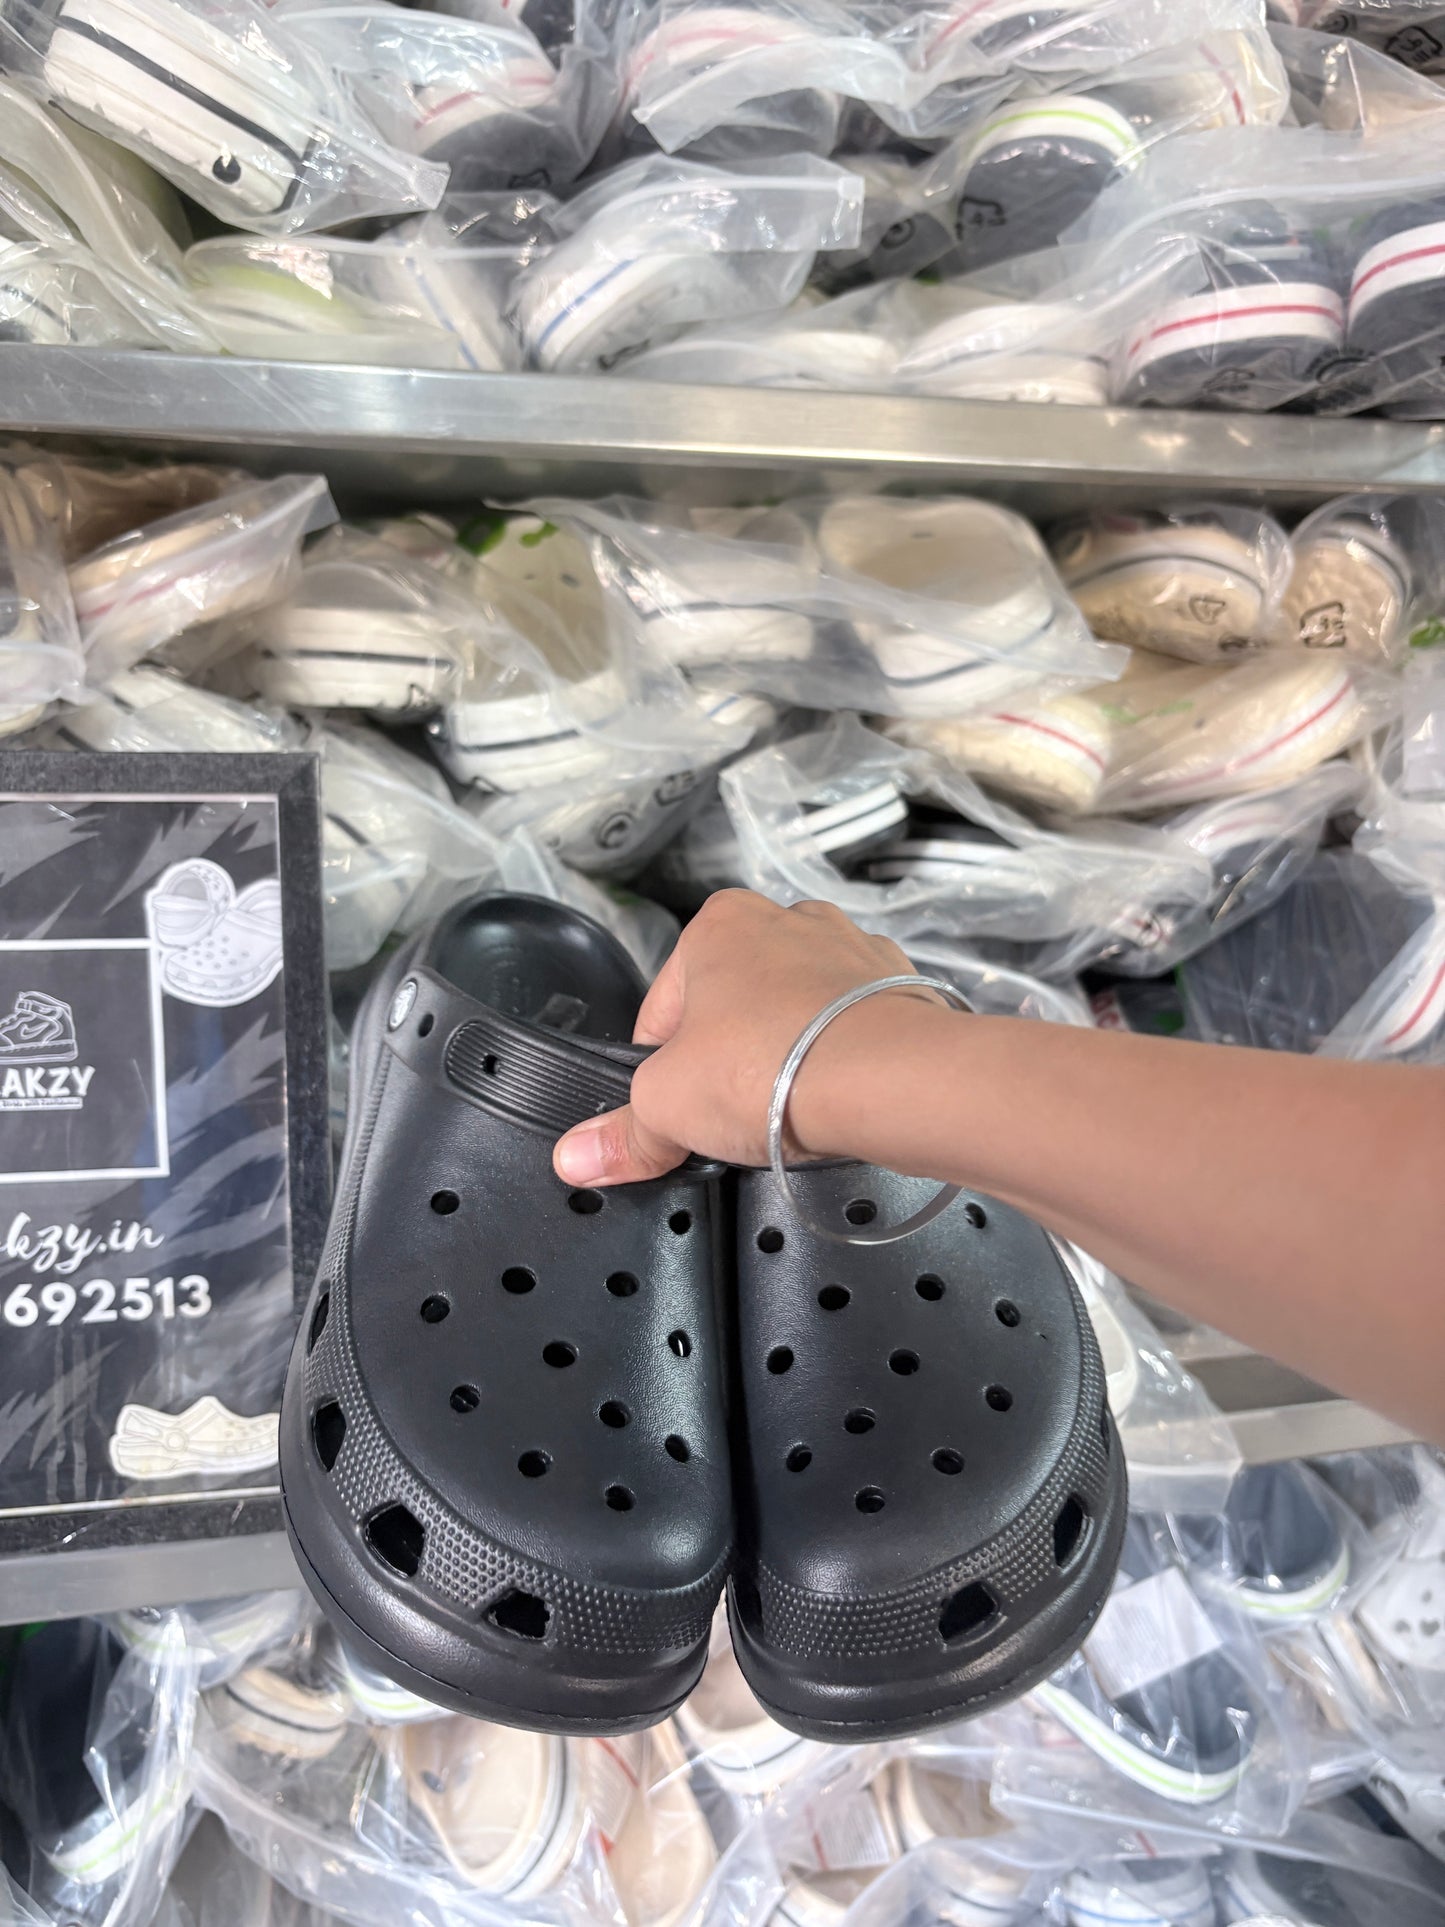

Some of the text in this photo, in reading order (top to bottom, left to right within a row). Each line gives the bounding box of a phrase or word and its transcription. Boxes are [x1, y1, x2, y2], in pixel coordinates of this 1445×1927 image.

[0, 1065, 96, 1098] AKZY
[0, 1212, 165, 1274] kzy.in
[4, 1275, 212, 1327] 692513
